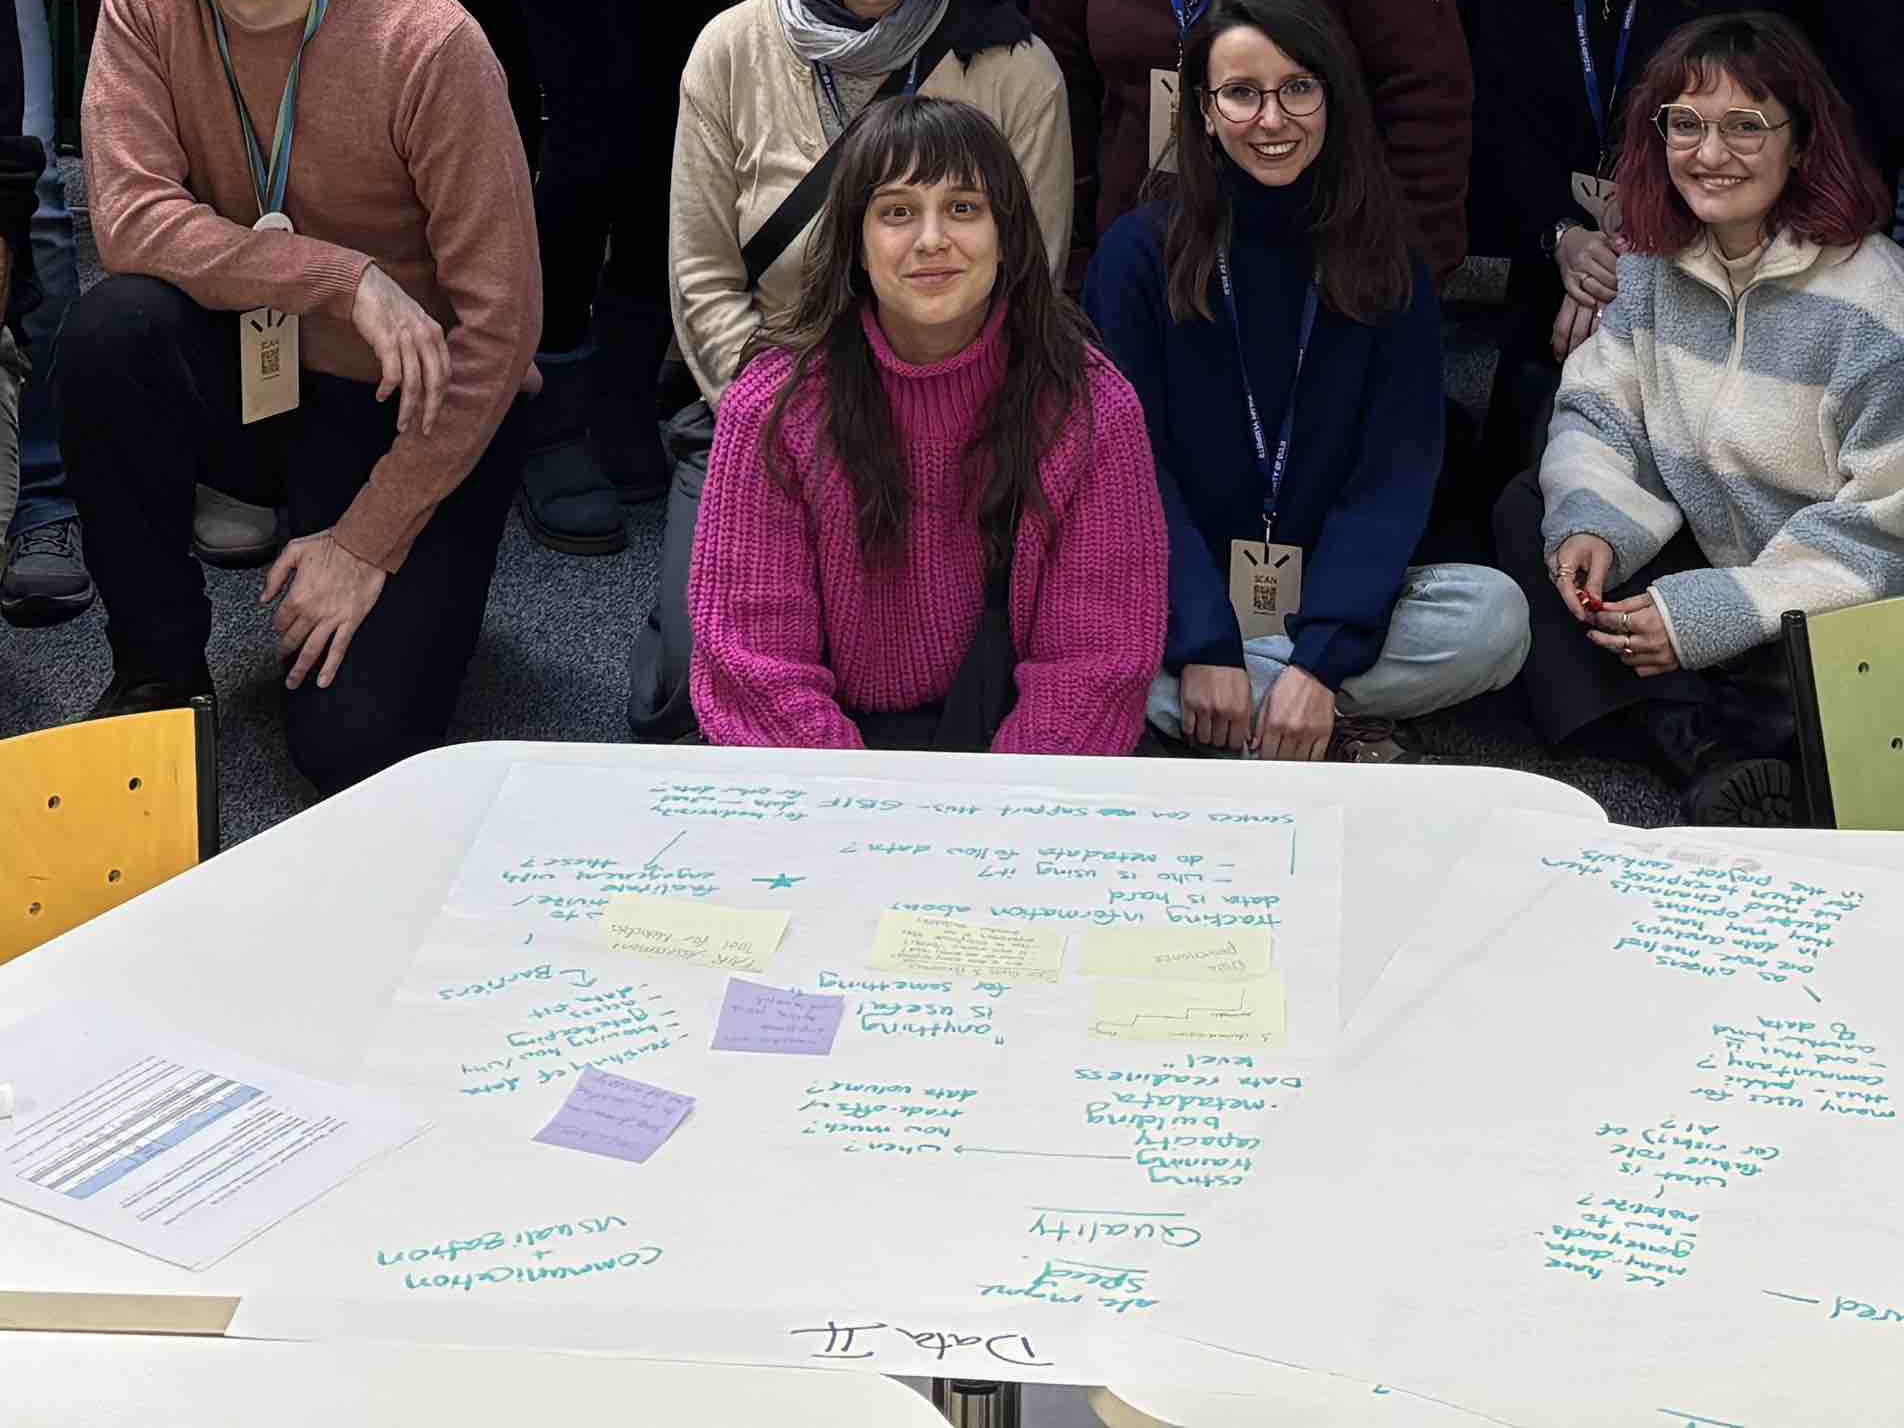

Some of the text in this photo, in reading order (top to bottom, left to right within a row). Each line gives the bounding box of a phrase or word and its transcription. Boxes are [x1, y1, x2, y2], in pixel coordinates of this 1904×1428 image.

[1253, 575, 1279, 585] SCAN
[1109, 890, 1170, 905] hard
[990, 905, 1281, 929] tracking information
[970, 1005, 993, 1020] is
[1108, 1092, 1265, 1112] metadata
[1085, 1102, 1221, 1132] building
[1135, 1129, 1261, 1152] capacity
[1028, 1213, 1202, 1248] Quality
[895, 1327, 1055, 1367] Data
